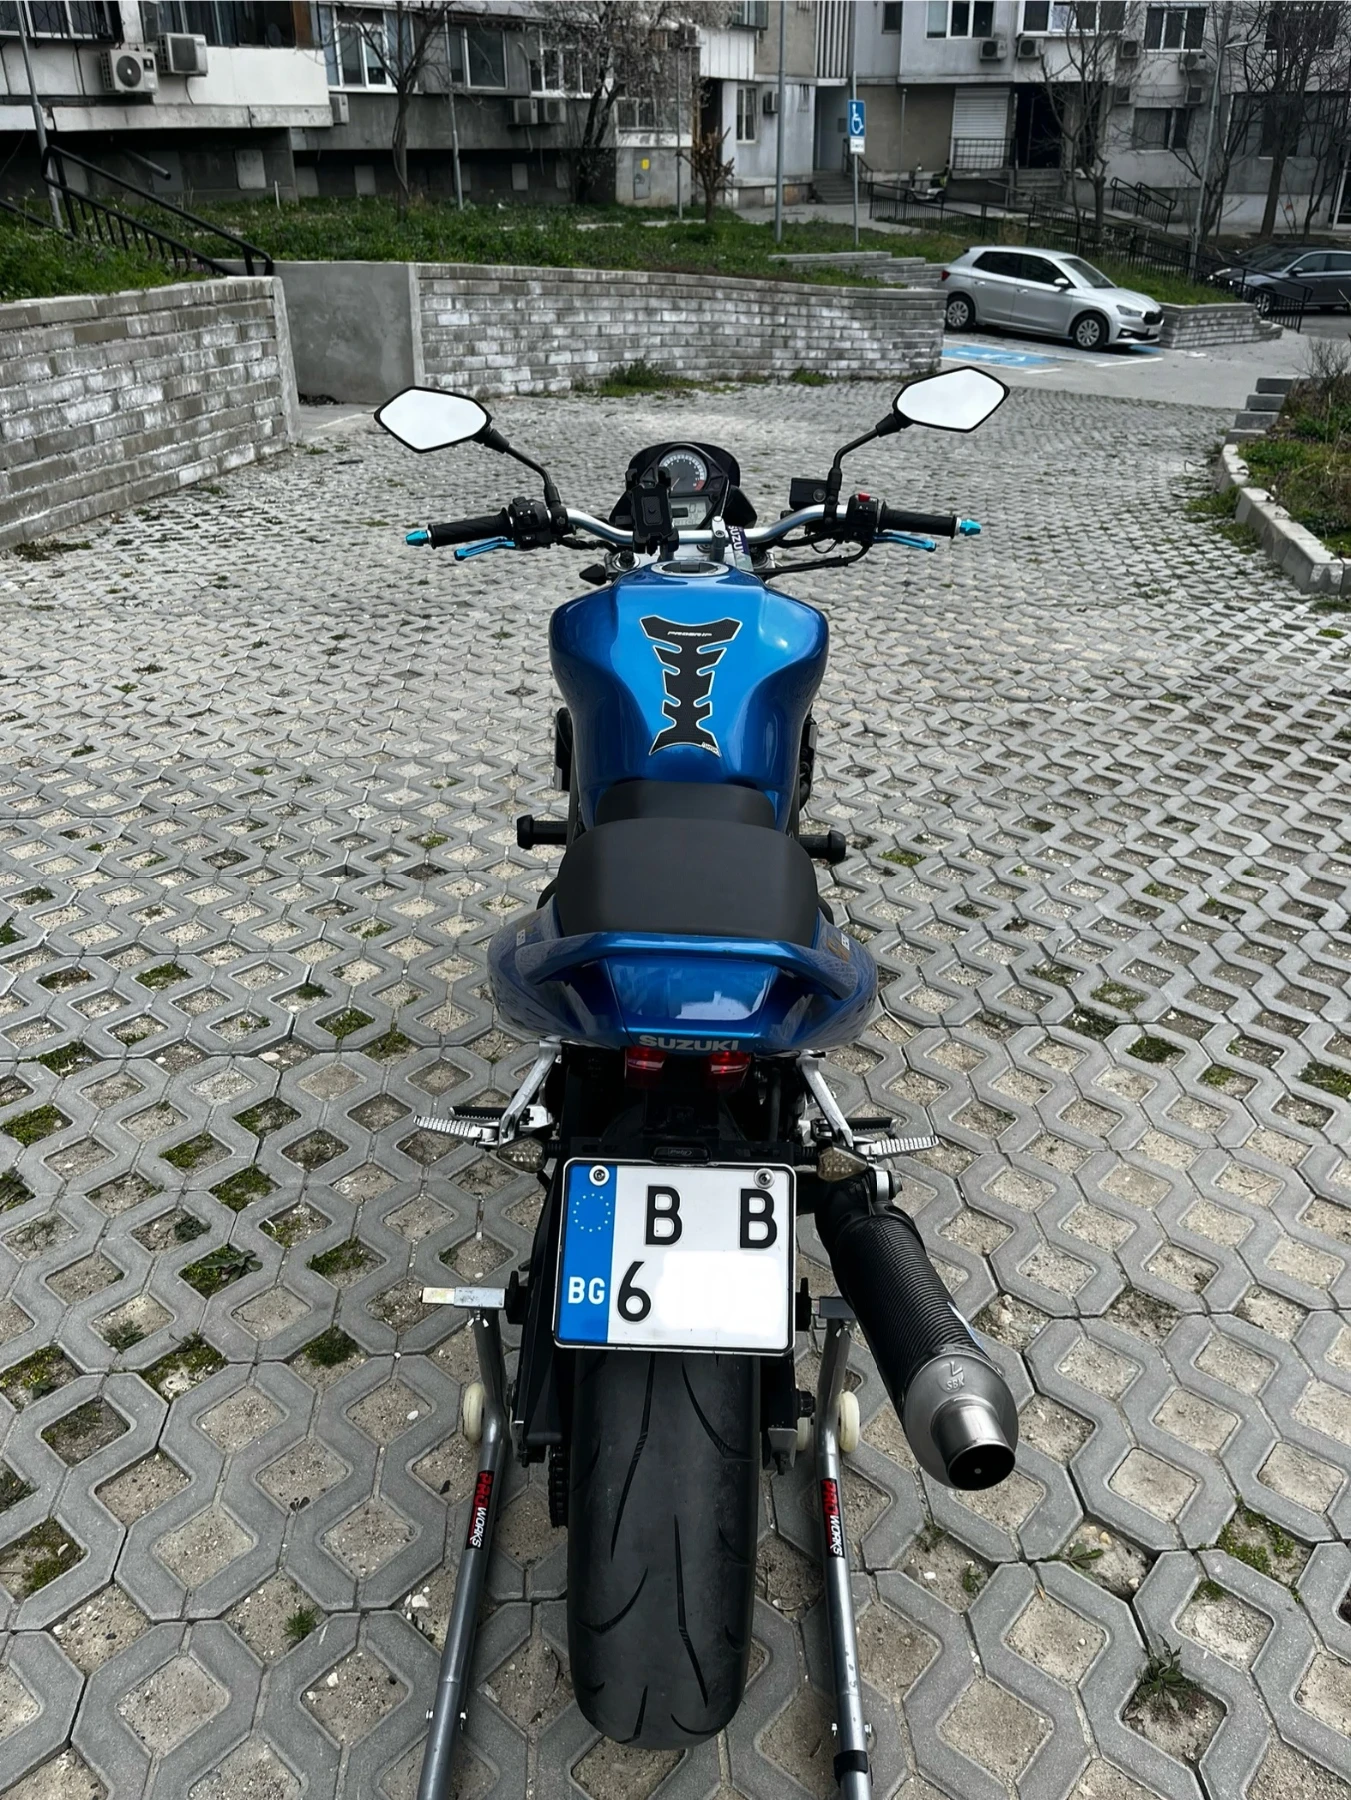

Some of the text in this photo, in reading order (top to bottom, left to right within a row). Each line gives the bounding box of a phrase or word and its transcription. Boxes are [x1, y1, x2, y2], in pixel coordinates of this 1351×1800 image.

[638, 1034, 740, 1052] SUZUKI
[645, 1185, 778, 1249] B B
[567, 1275, 606, 1305] BG
[617, 1260, 652, 1323] 6
[946, 1378, 965, 1391] SBK
